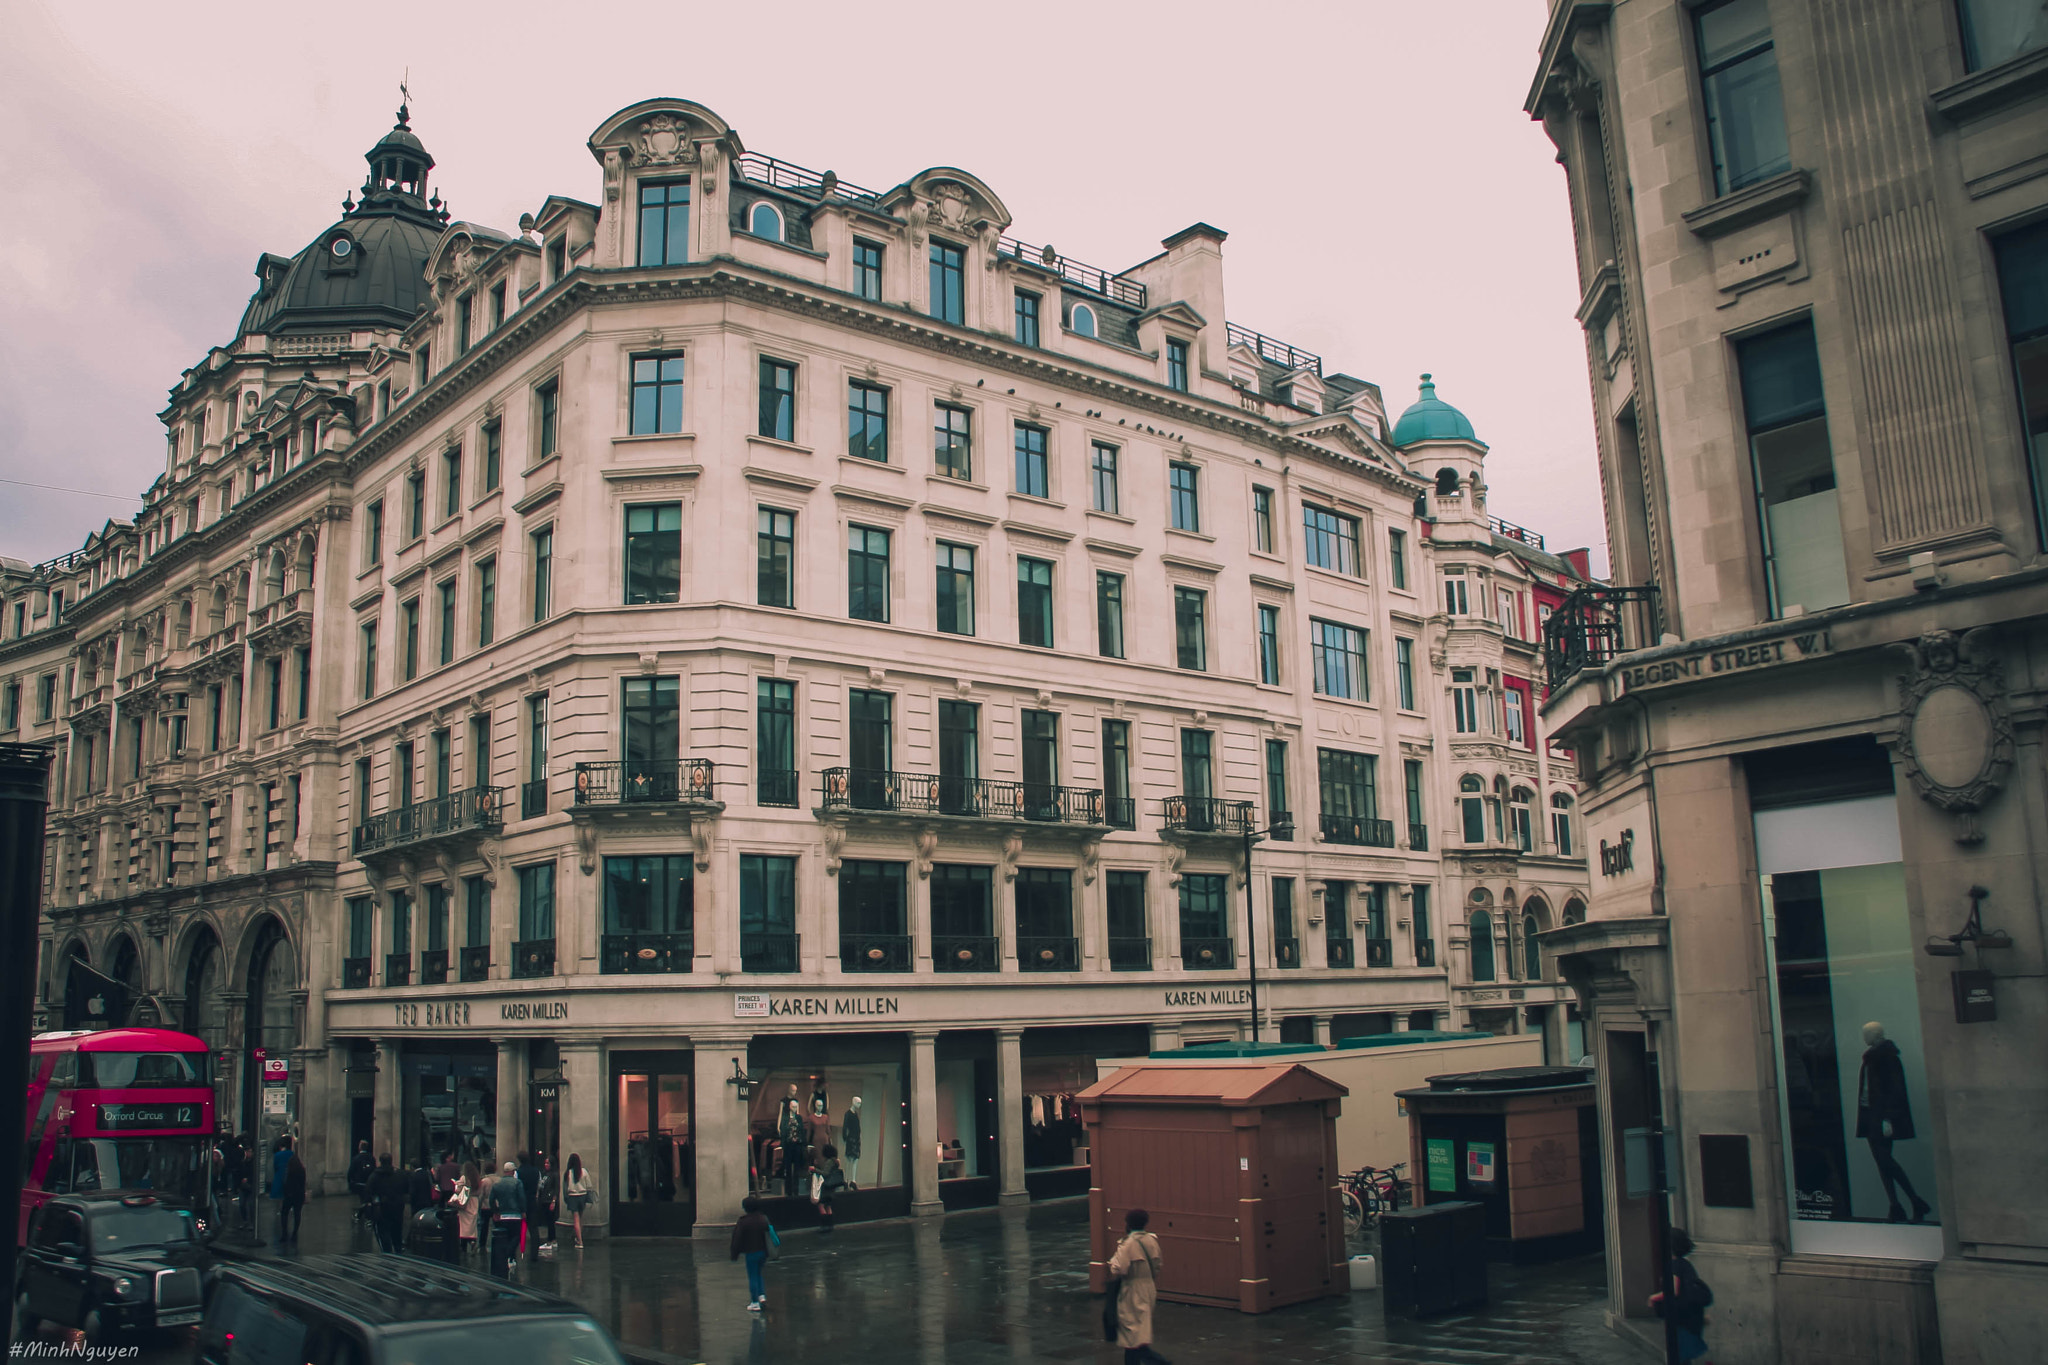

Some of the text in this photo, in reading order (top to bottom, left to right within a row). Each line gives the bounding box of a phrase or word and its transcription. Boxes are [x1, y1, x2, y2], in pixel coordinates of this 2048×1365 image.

[1622, 656, 1704, 688] REGENT
[1711, 641, 1785, 673] STREET
[770, 997, 898, 1015] KAREN MILLEN
[1165, 990, 1252, 1006] KAREN MILLEN
[395, 1002, 471, 1026] TED BAKER
[501, 1002, 568, 1020] KAREN MILLEN
[540, 1088, 555, 1097] KM
[104, 1107, 191, 1122] Oxford Circus 12
